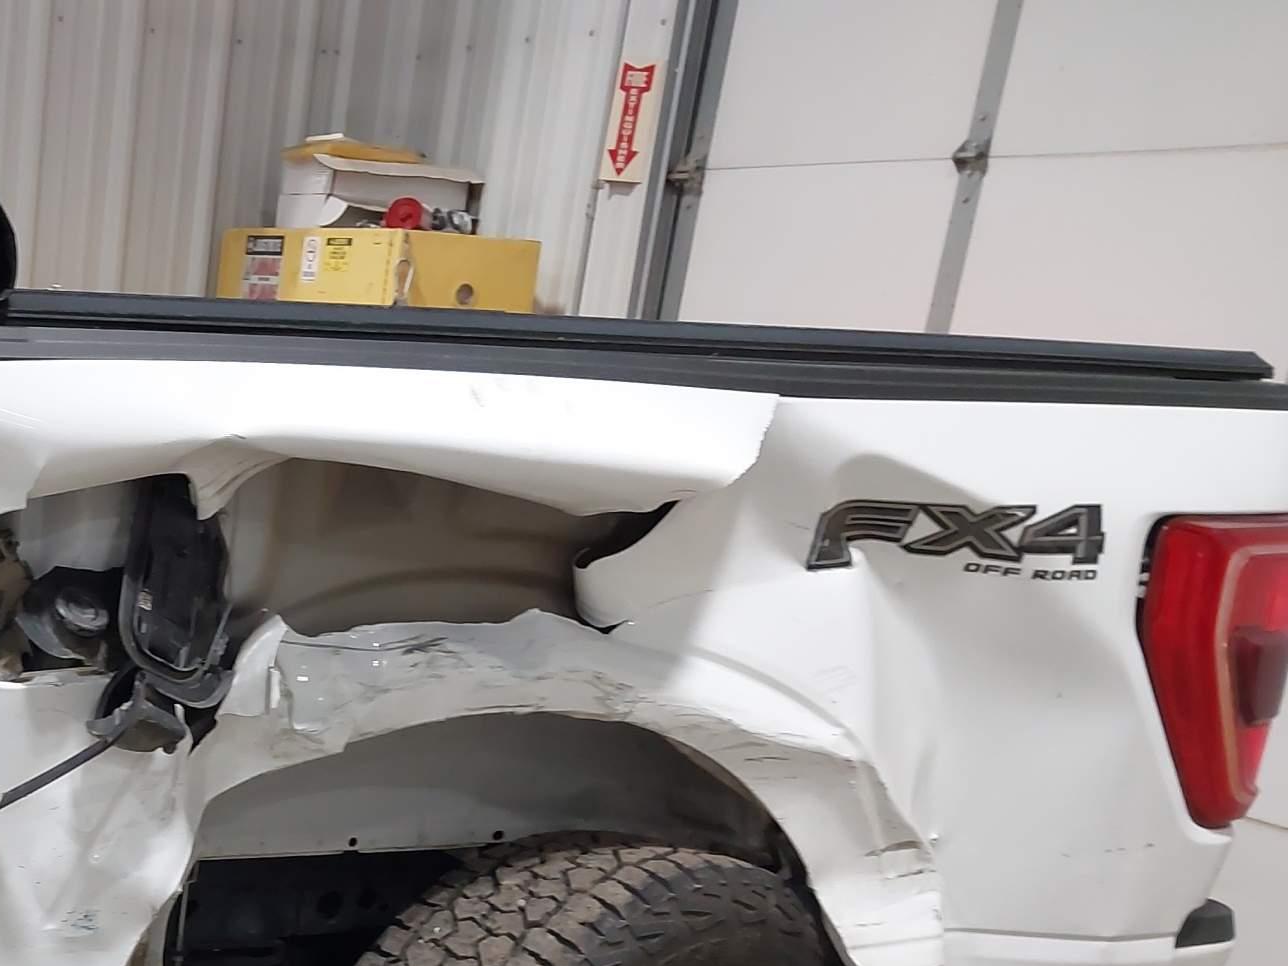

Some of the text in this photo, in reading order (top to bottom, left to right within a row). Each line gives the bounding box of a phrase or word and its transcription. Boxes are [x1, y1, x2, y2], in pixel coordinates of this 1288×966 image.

[805, 499, 1104, 572] FX4
[962, 562, 1097, 581] OFF ROAD
